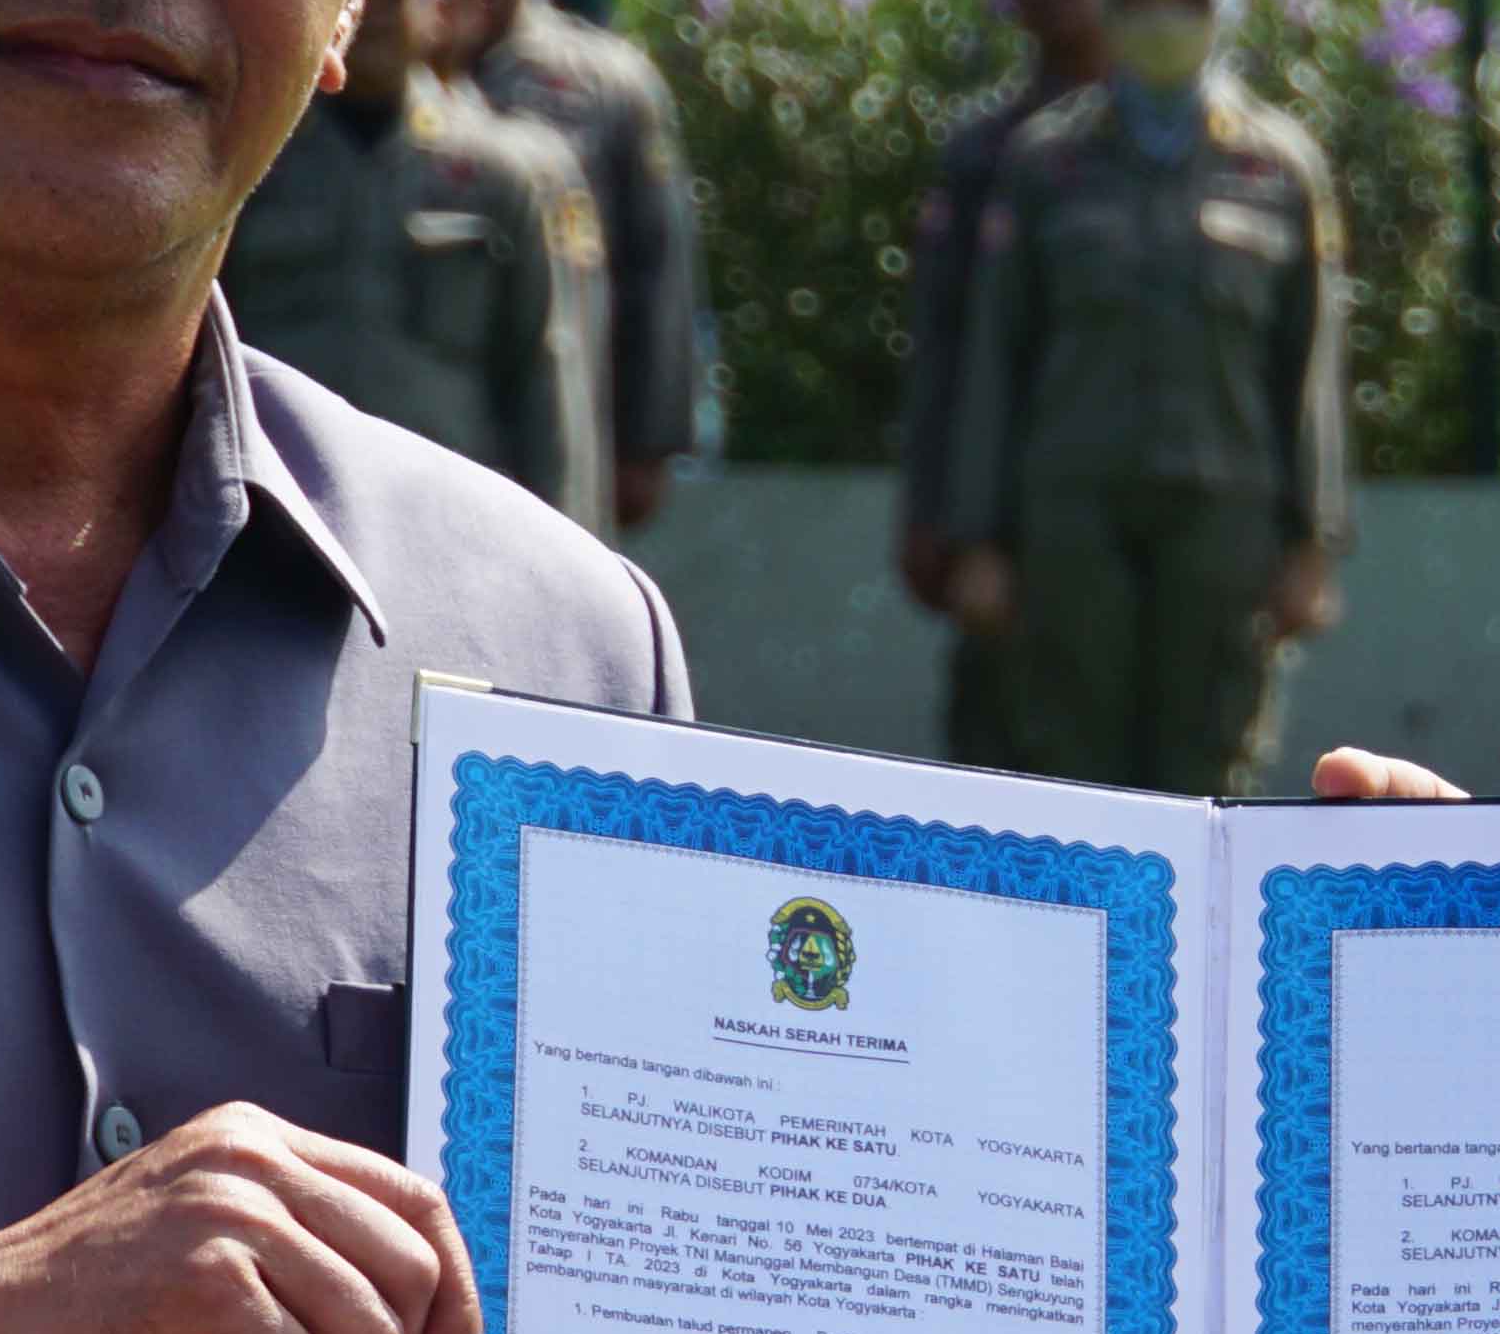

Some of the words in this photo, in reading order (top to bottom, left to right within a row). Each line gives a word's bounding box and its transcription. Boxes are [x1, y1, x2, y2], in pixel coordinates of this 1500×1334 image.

[713, 1015, 781, 1038] NASKAH
[784, 1027, 841, 1045] SERAH
[845, 1034, 908, 1052] TERIMA
[533, 1040, 571, 1061] Yang
[575, 1047, 638, 1069] bertanda
[641, 1059, 691, 1078] tangan
[691, 1067, 753, 1087] dibawah
[755, 1075, 773, 1091] ini
[580, 1102, 693, 1131] SELANJUTNYA
[697, 1120, 767, 1141] DISEBUT
[770, 1130, 822, 1148] PIHAK
[825, 1136, 849, 1151] KE
[673, 1099, 756, 1123] WALIKOTA
[779, 1114, 886, 1137] PEMERINTAH
[910, 1128, 954, 1146] KOTA
[977, 1138, 1085, 1166] YOGYAKARTA
[1351, 1141, 1390, 1157] Yang
[1394, 1141, 1461, 1154] bertanda
[577, 1156, 692, 1185] SELANJUTNYA
[695, 1174, 766, 1194] DISEBUT
[769, 1183, 820, 1201] PIHAK
[824, 1189, 848, 1203] KE
[626, 1147, 717, 1171] KOMANDAN
[758, 1165, 812, 1182] KODIM
[853, 1175, 938, 1196] 0734/KOTA
[977, 1191, 1085, 1218] YOGYAKARTA
[1350, 1283, 1391, 1296] Pada
[1407, 1282, 1436, 1296] hari
[1453, 1282, 1472, 1295] ini
[1353, 1300, 1388, 1314] Kota
[1396, 1300, 1481, 1316] Yogyakarta
